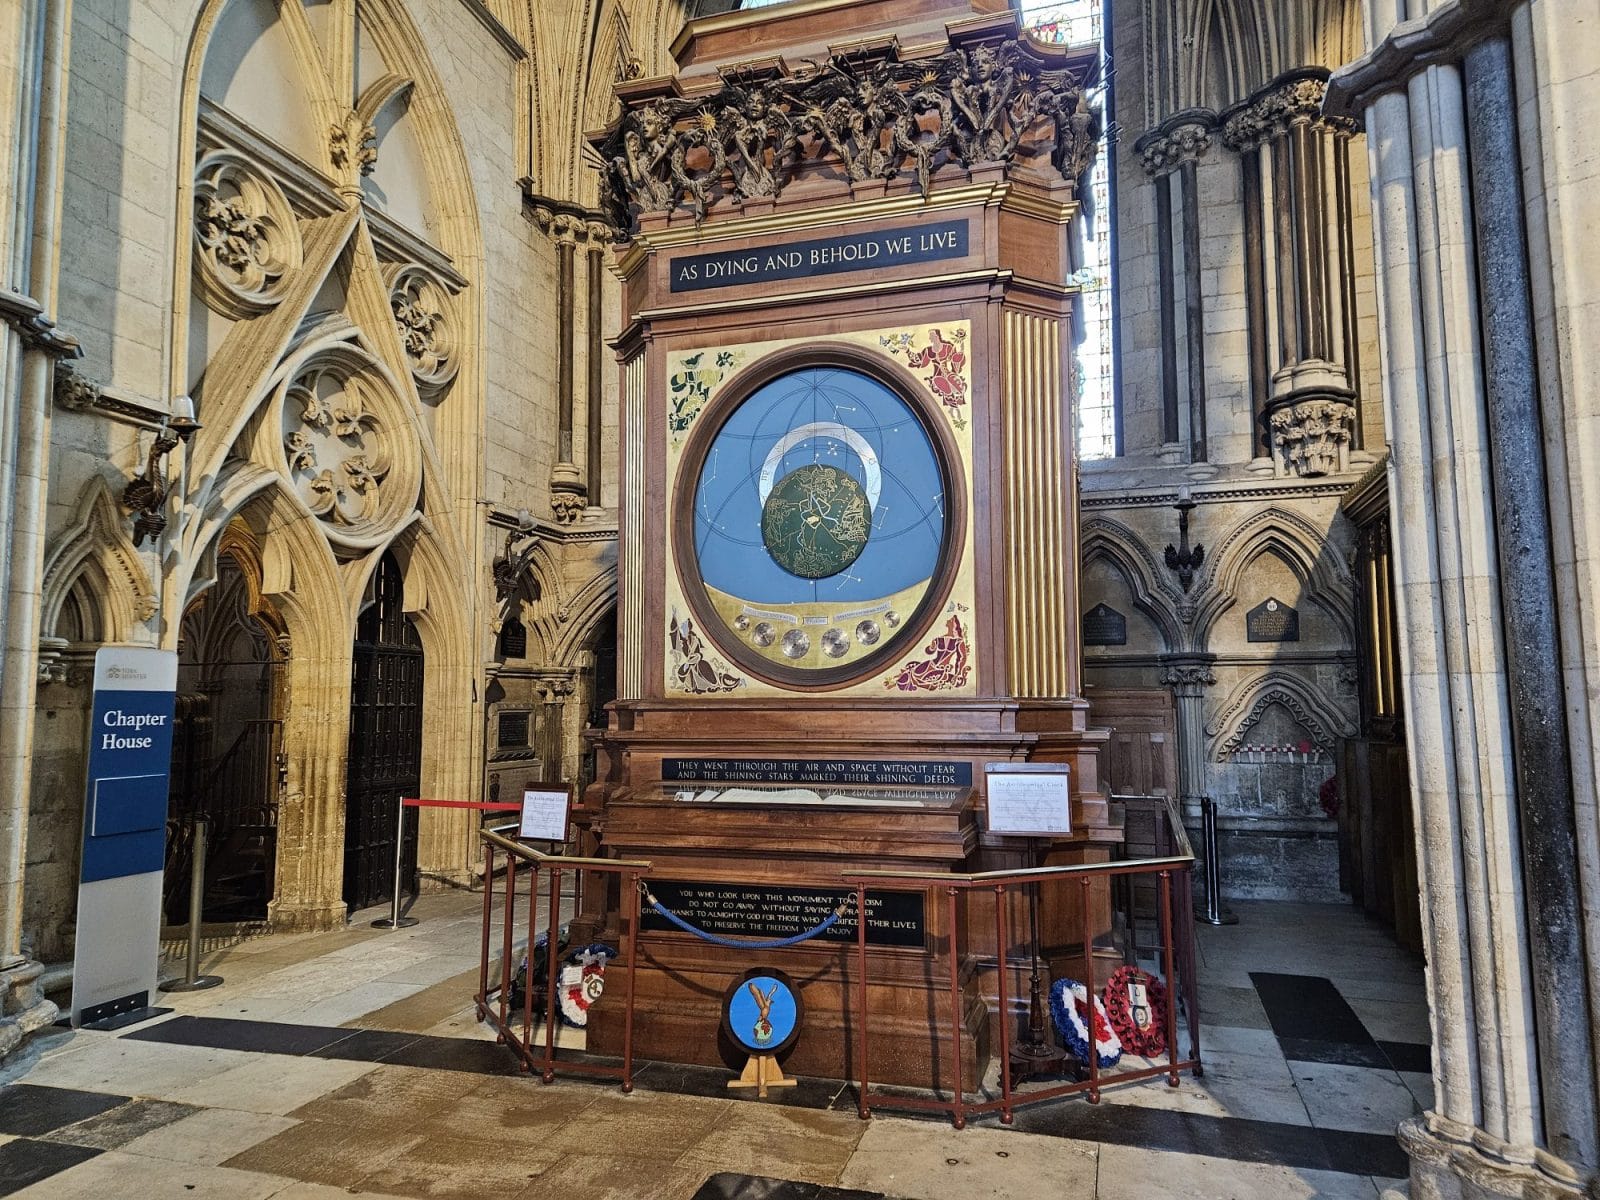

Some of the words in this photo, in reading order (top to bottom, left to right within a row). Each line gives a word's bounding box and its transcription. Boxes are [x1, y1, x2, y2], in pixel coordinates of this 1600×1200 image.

[679, 264, 698, 281] AS
[705, 257, 758, 278] DYING
[764, 252, 803, 271] AND
[810, 241, 880, 265] BEHOLD
[886, 237, 912, 256] WE
[920, 231, 957, 251] LIVE
[103, 710, 167, 731] Chapter
[102, 733, 152, 749] House
[677, 761, 699, 770] THEY
[703, 761, 729, 770] WENT
[735, 762, 777, 771] THROUGH
[783, 762, 799, 771] THE
[804, 763, 819, 772] AIR
[825, 763, 845, 772] AND
[850, 763, 877, 773] SPACE
[883, 764, 927, 773] WITHOUT
[933, 765, 955, 774] FEAR
[677, 771, 696, 779] AND
[703, 771, 718, 779] THE
[725, 771, 762, 780] SHINING
[769, 772, 794, 780] STARS
[800, 772, 836, 781] MARKED
[843, 773, 870, 782] THEIR
[876, 774, 916, 783] SHINING
[924, 774, 955, 784] DEEDS
[787, 895, 834, 903] MONUMENT
[689, 900, 700, 908] DO
[761, 904, 800, 912] WITHOUT
[804, 906, 831, 914] SAYING
[845, 908, 874, 917] PRAER
[641, 907, 662, 915] GIVIN
[707, 911, 745, 919] ALMIGHTY
[746, 912, 760, 920] GOD
[776, 914, 800, 922] THOSE
[867, 919, 890, 928] THEIR
[892, 921, 917, 930] LIVES
[714, 921, 746, 929] PRESERVE
[766, 924, 799, 932] FREEDOM
[826, 927, 852, 935] ENJOY
